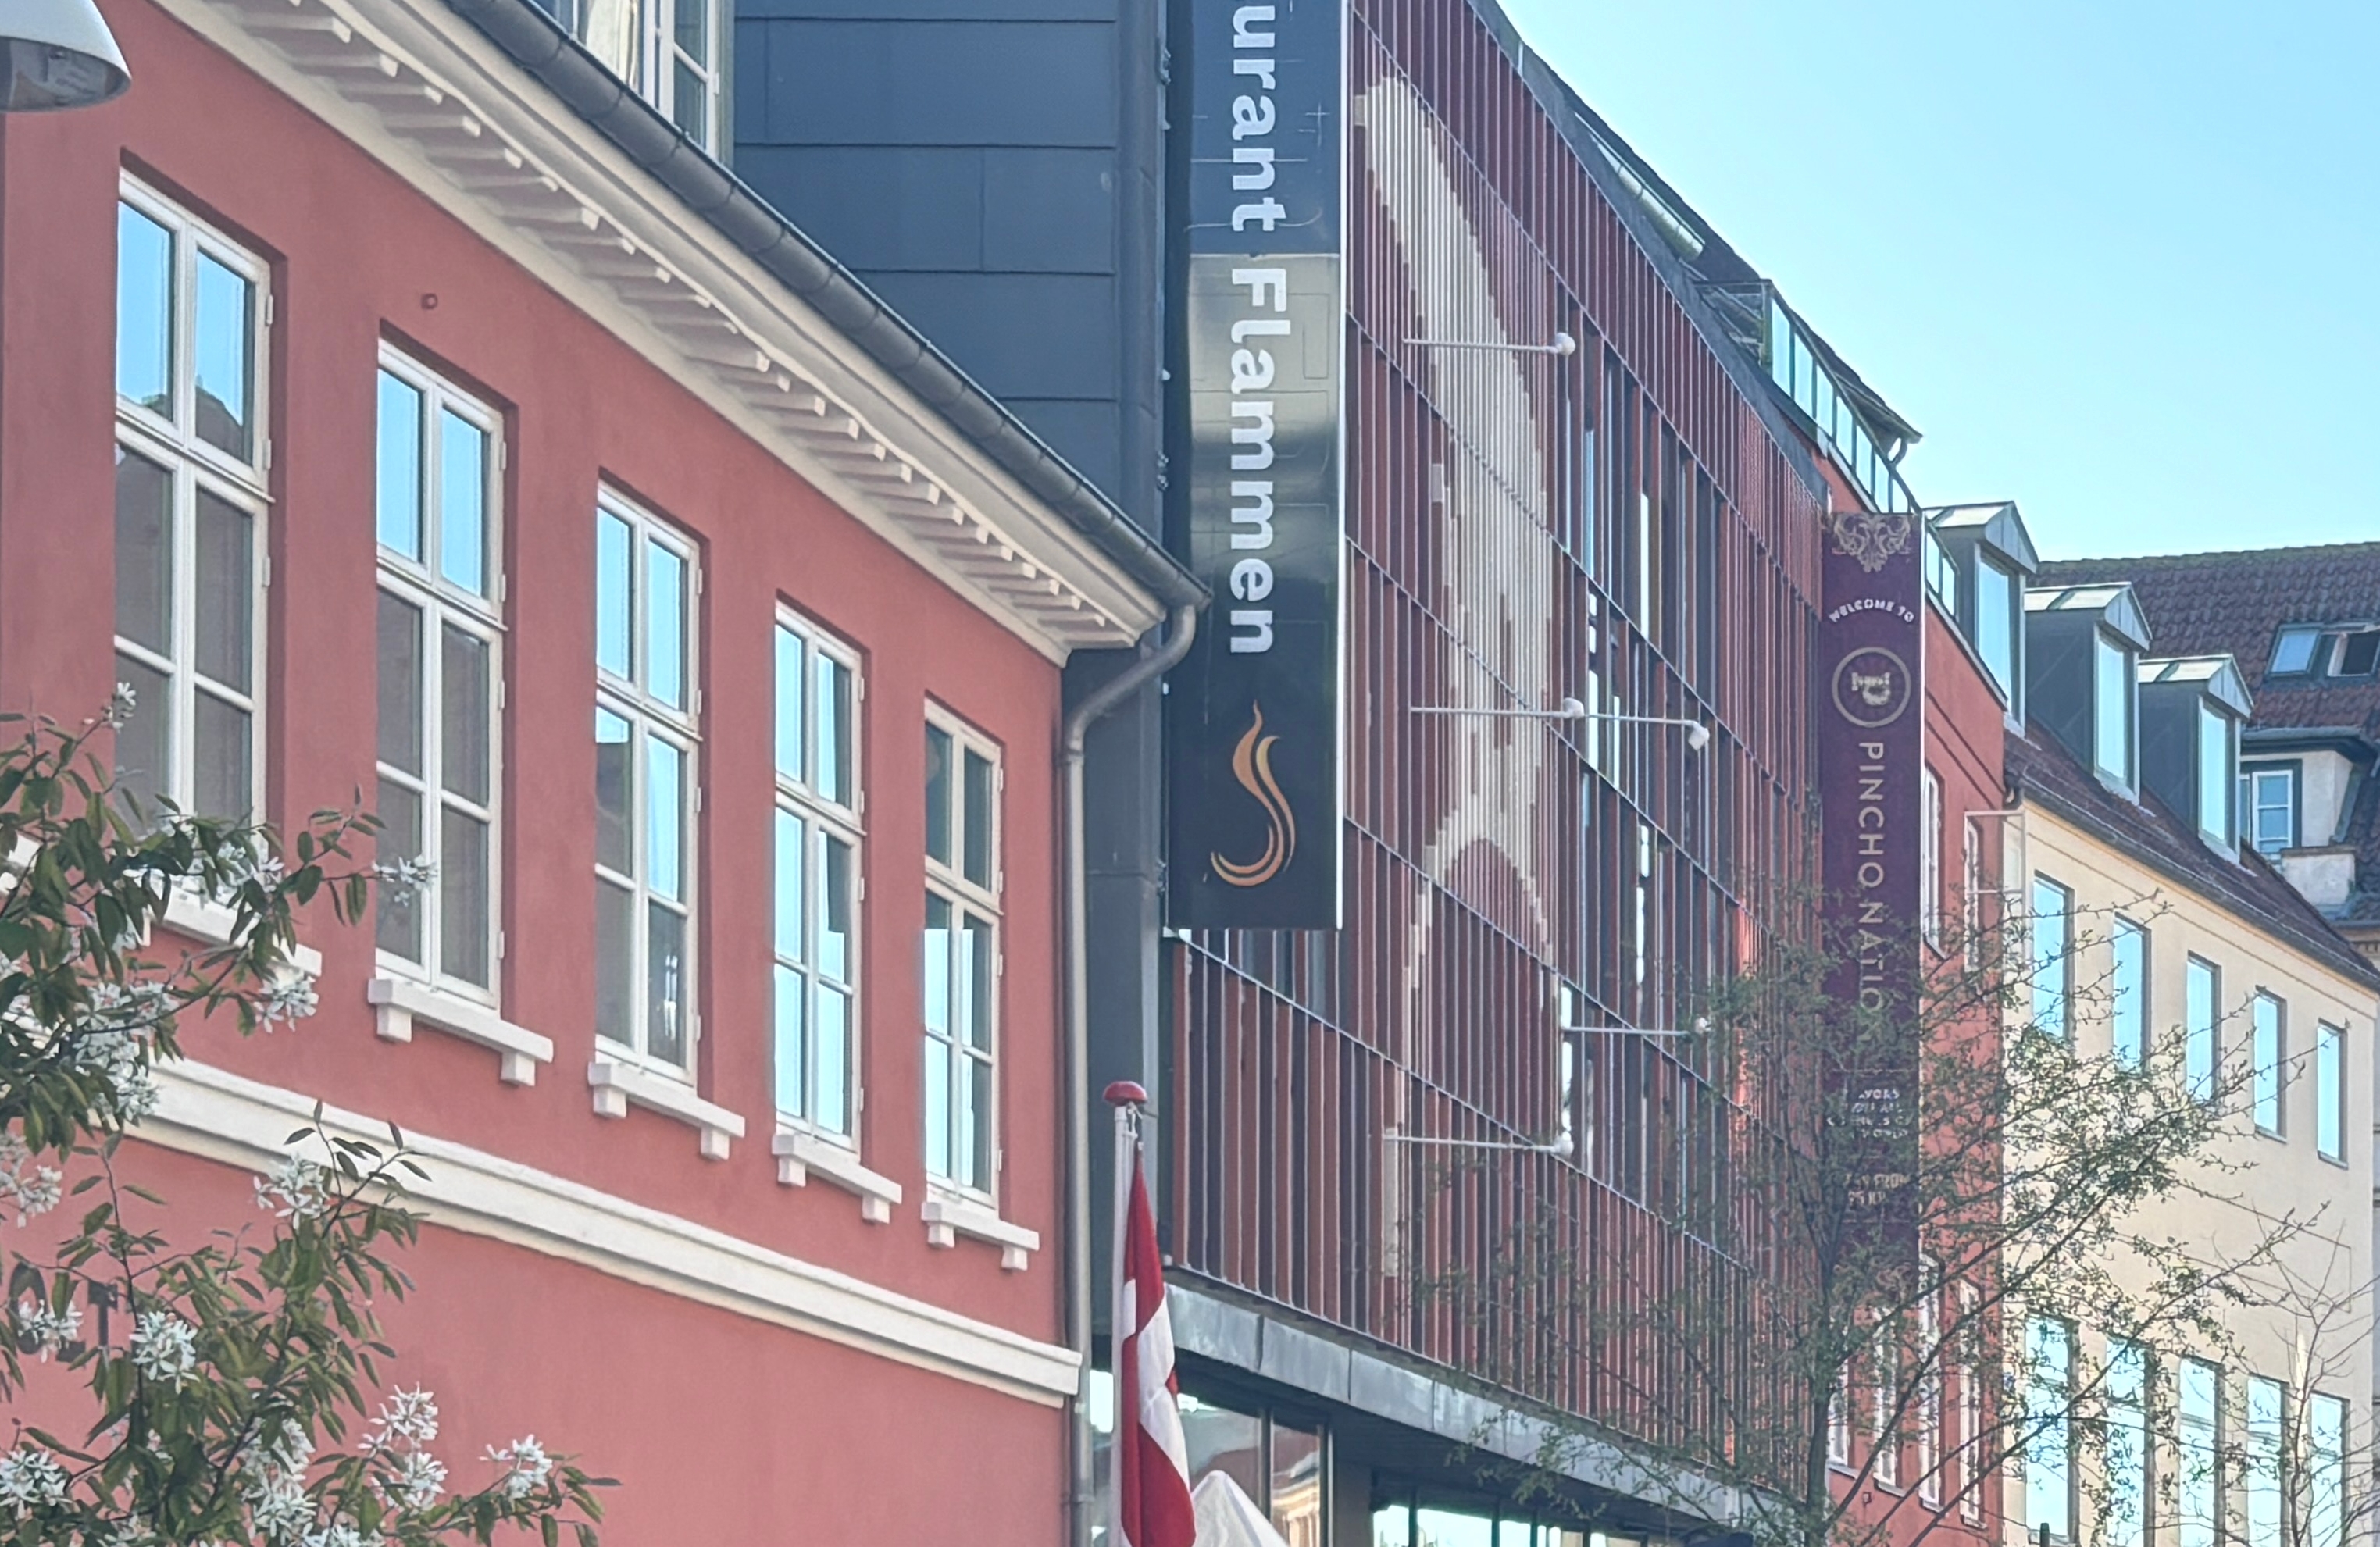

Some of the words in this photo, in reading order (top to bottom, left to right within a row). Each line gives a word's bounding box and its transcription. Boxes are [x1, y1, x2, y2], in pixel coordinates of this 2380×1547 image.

[1229, 268, 1291, 654] Flammen
[1828, 598, 1895, 623] WELCOME
[1897, 605, 1915, 623] TO
[1858, 742, 1885, 889] PINCHO
[1858, 902, 1885, 1041] NATIO
